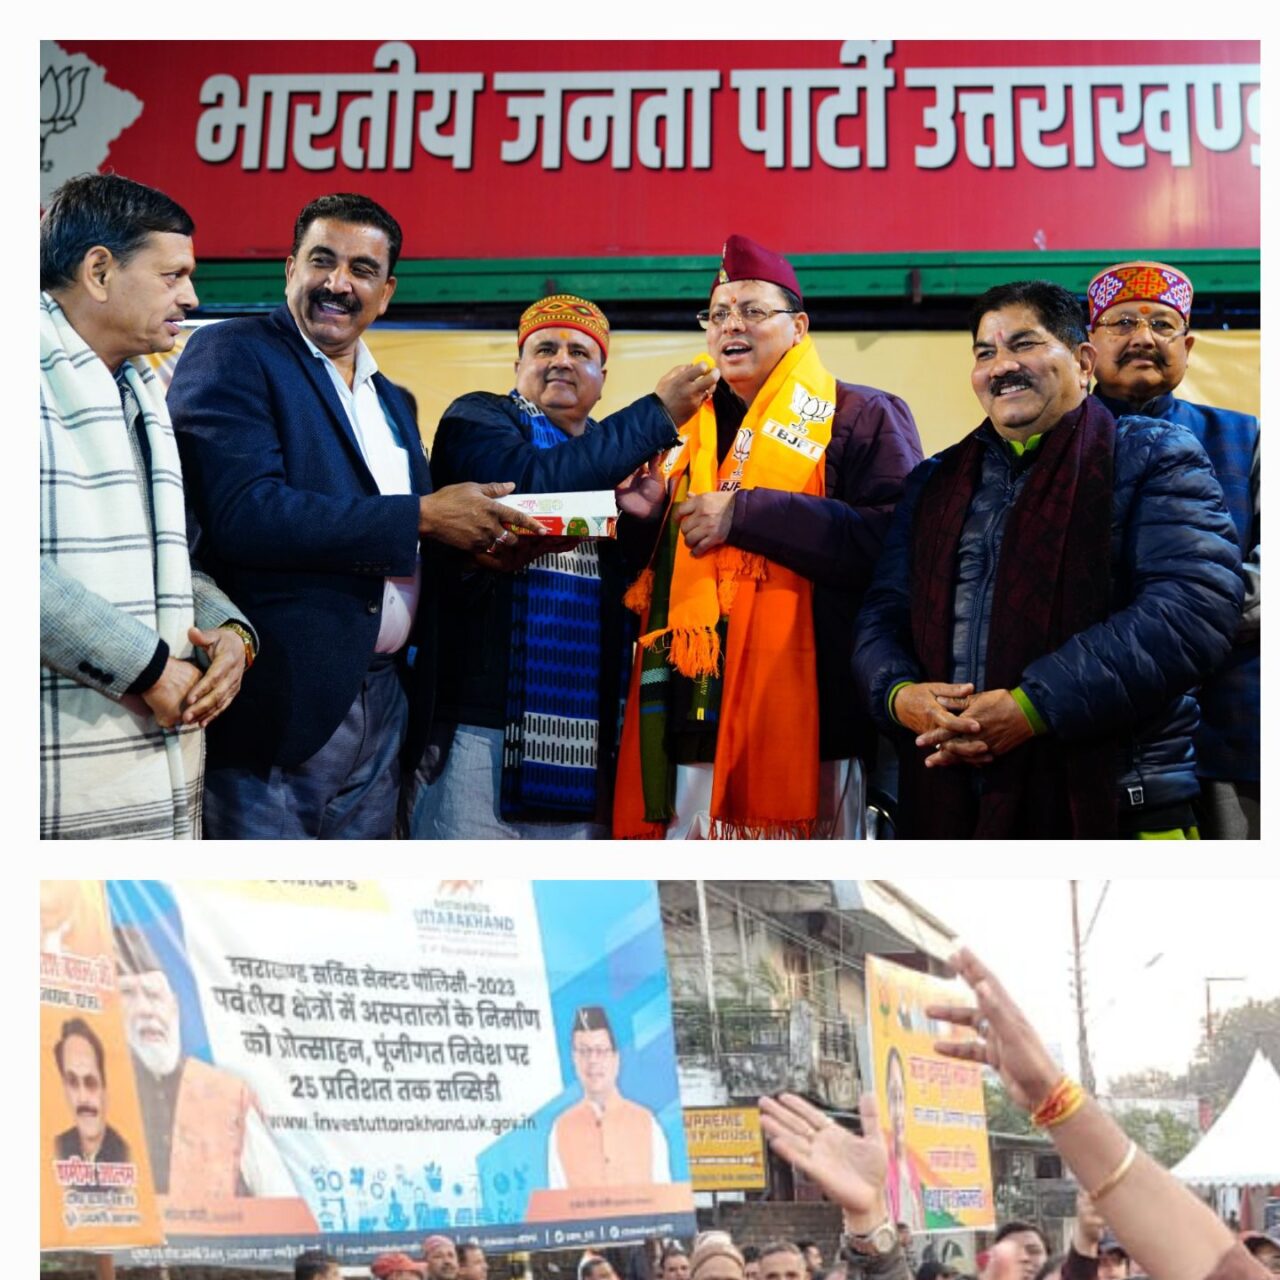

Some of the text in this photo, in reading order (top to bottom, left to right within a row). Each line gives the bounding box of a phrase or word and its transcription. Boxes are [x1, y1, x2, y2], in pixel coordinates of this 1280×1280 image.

[195, 41, 484, 171] भारतीय
[494, 70, 721, 170] जनता
[729, 40, 896, 169] पार्टी
[413, 908, 515, 931] UTTARAKHAND
[336, 992, 357, 1023] में
[361, 997, 450, 1028] अस्पतालों
[453, 998, 474, 1029] के
[477, 999, 541, 1032] निर्माण
[240, 1024, 272, 1057] को
[447, 1034, 503, 1066] निवेश
[504, 1043, 531, 1066] पर
[289, 1075, 319, 1099] 25
[319, 1069, 393, 1102] प्रतिशत
[394, 1077, 432, 1102] तक
